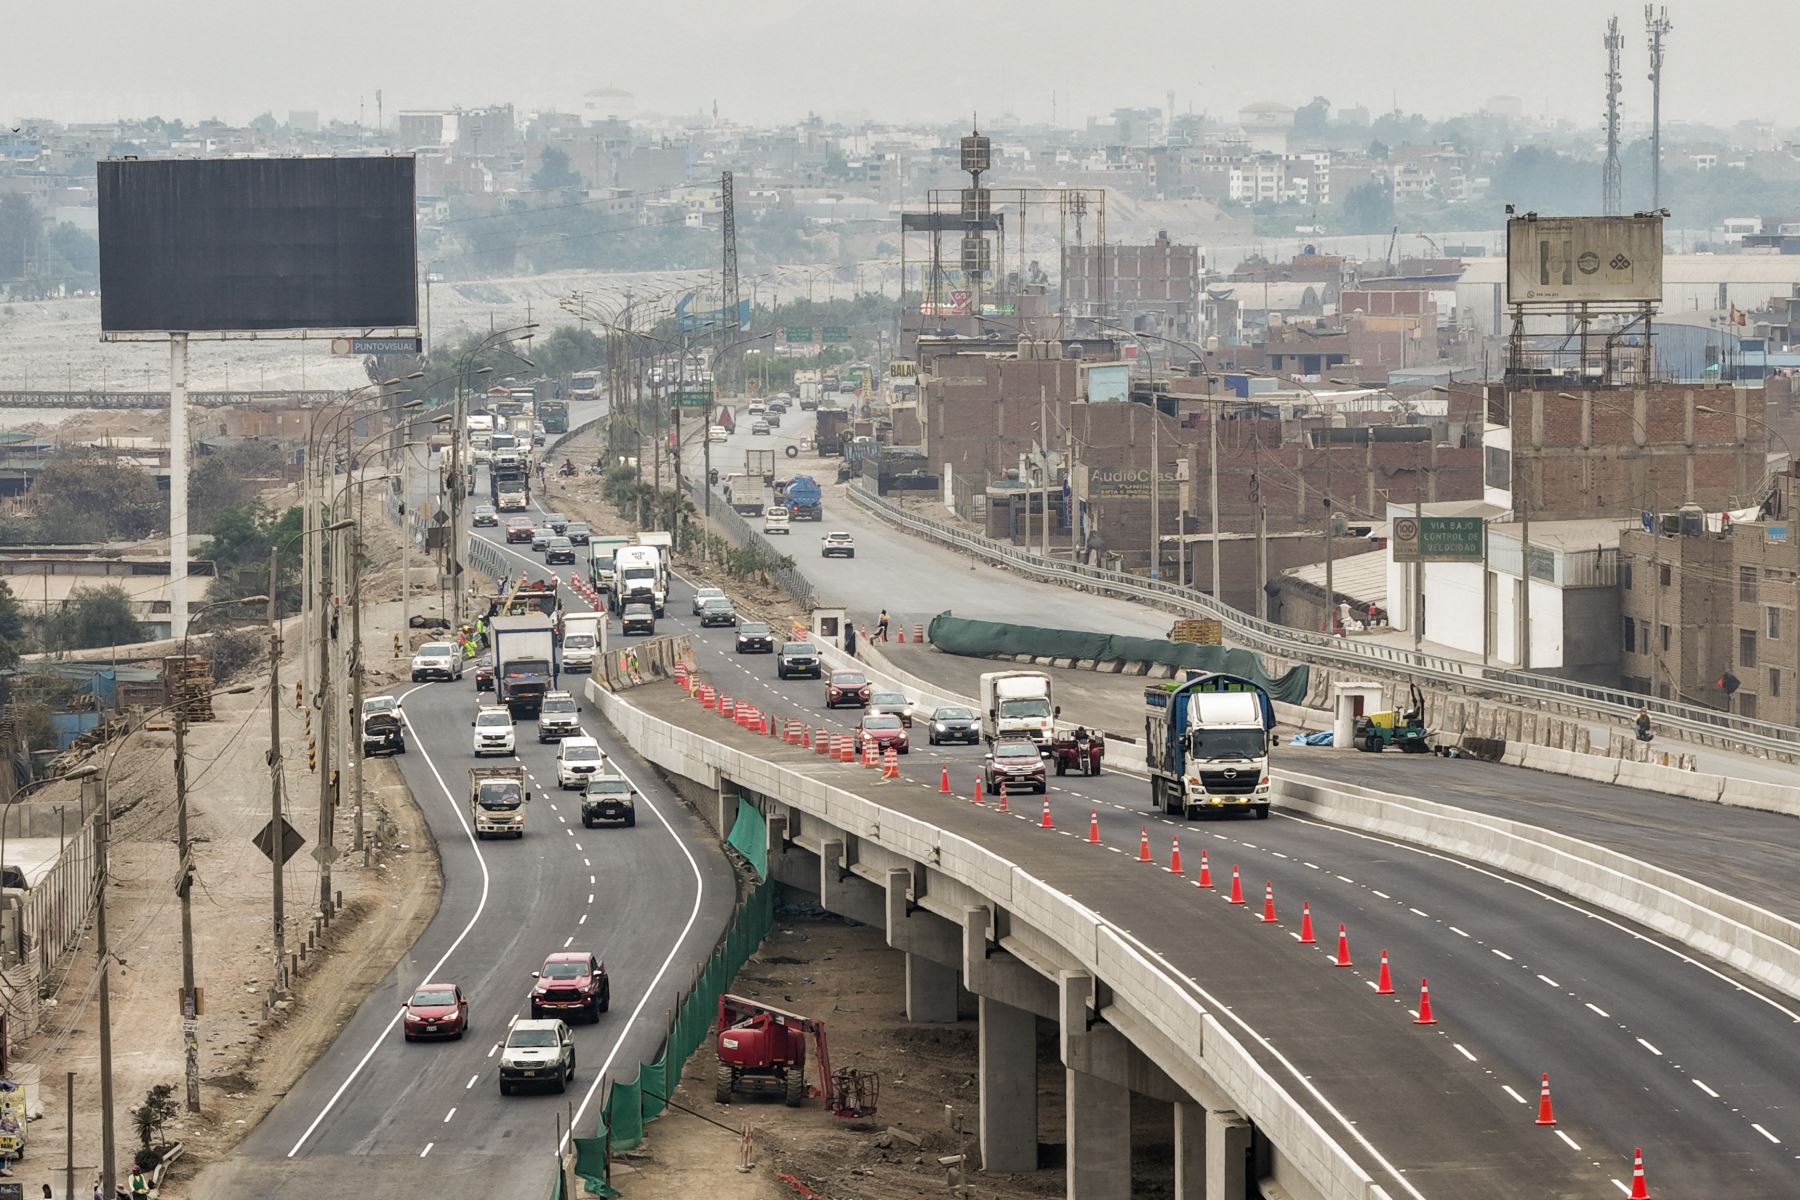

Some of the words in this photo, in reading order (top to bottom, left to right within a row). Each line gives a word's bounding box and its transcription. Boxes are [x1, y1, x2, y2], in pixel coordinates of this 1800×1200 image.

[355, 342, 414, 351] PUNTOVISUAL
[1399, 524, 1414, 533] 100
[1424, 533, 1463, 541] CONTROL
[1468, 533, 1479, 541] DE
